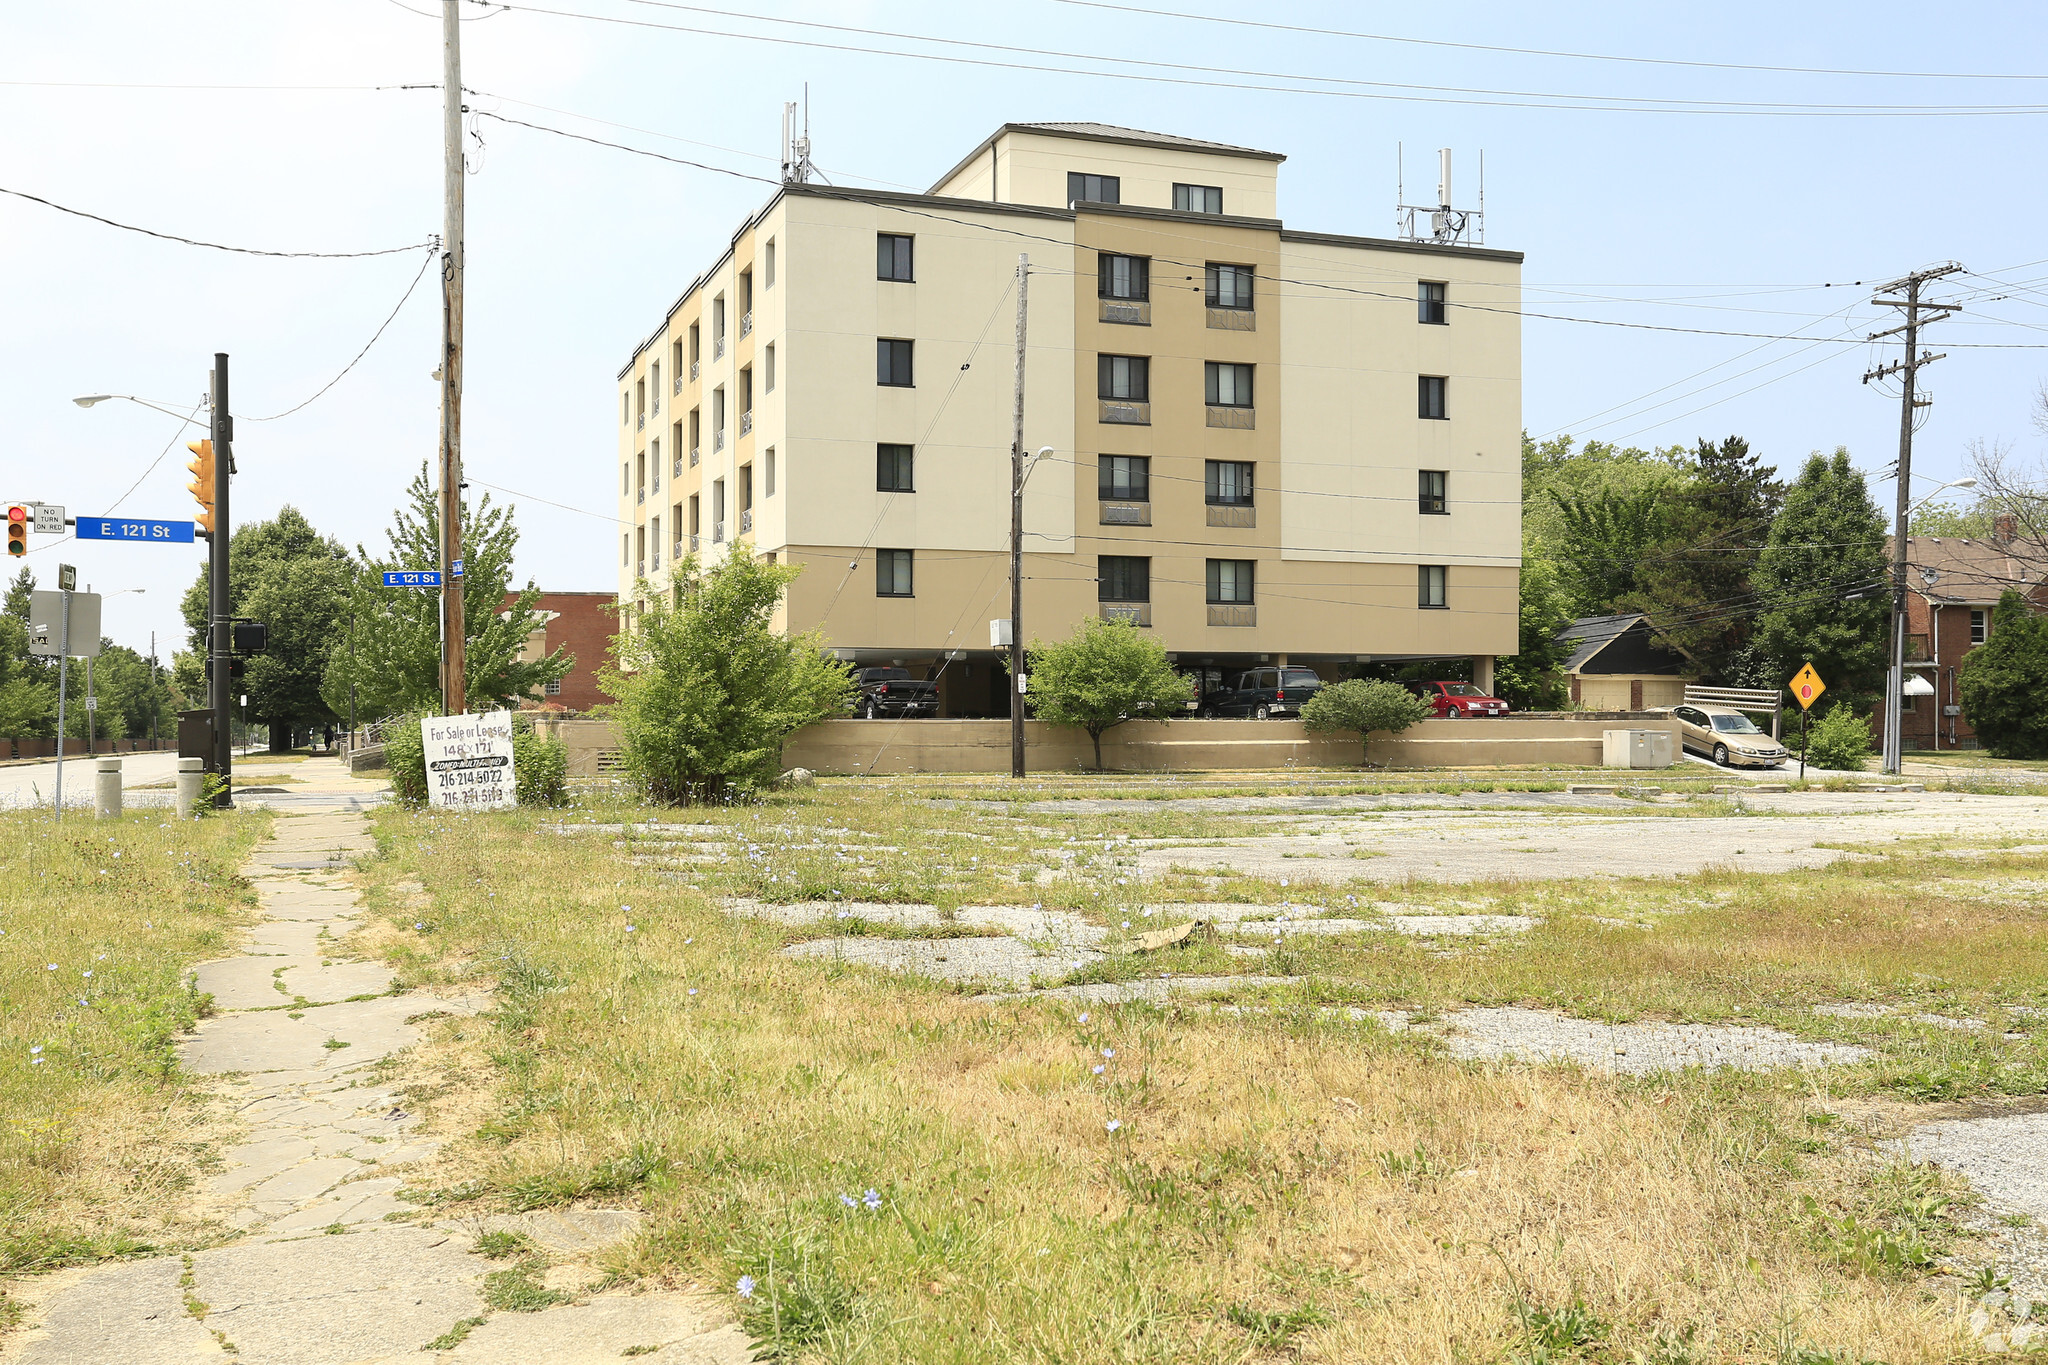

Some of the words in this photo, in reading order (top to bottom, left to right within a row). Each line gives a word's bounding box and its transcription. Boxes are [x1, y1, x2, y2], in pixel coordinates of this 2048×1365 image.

[101, 523, 115, 536] E.
[121, 524, 147, 537] 121
[152, 525, 170, 538] St
[389, 574, 399, 584] E.
[402, 574, 419, 583] 121
[422, 573, 435, 583] St
[430, 727, 444, 741] For
[446, 726, 465, 740] Sale
[466, 727, 475, 736] or
